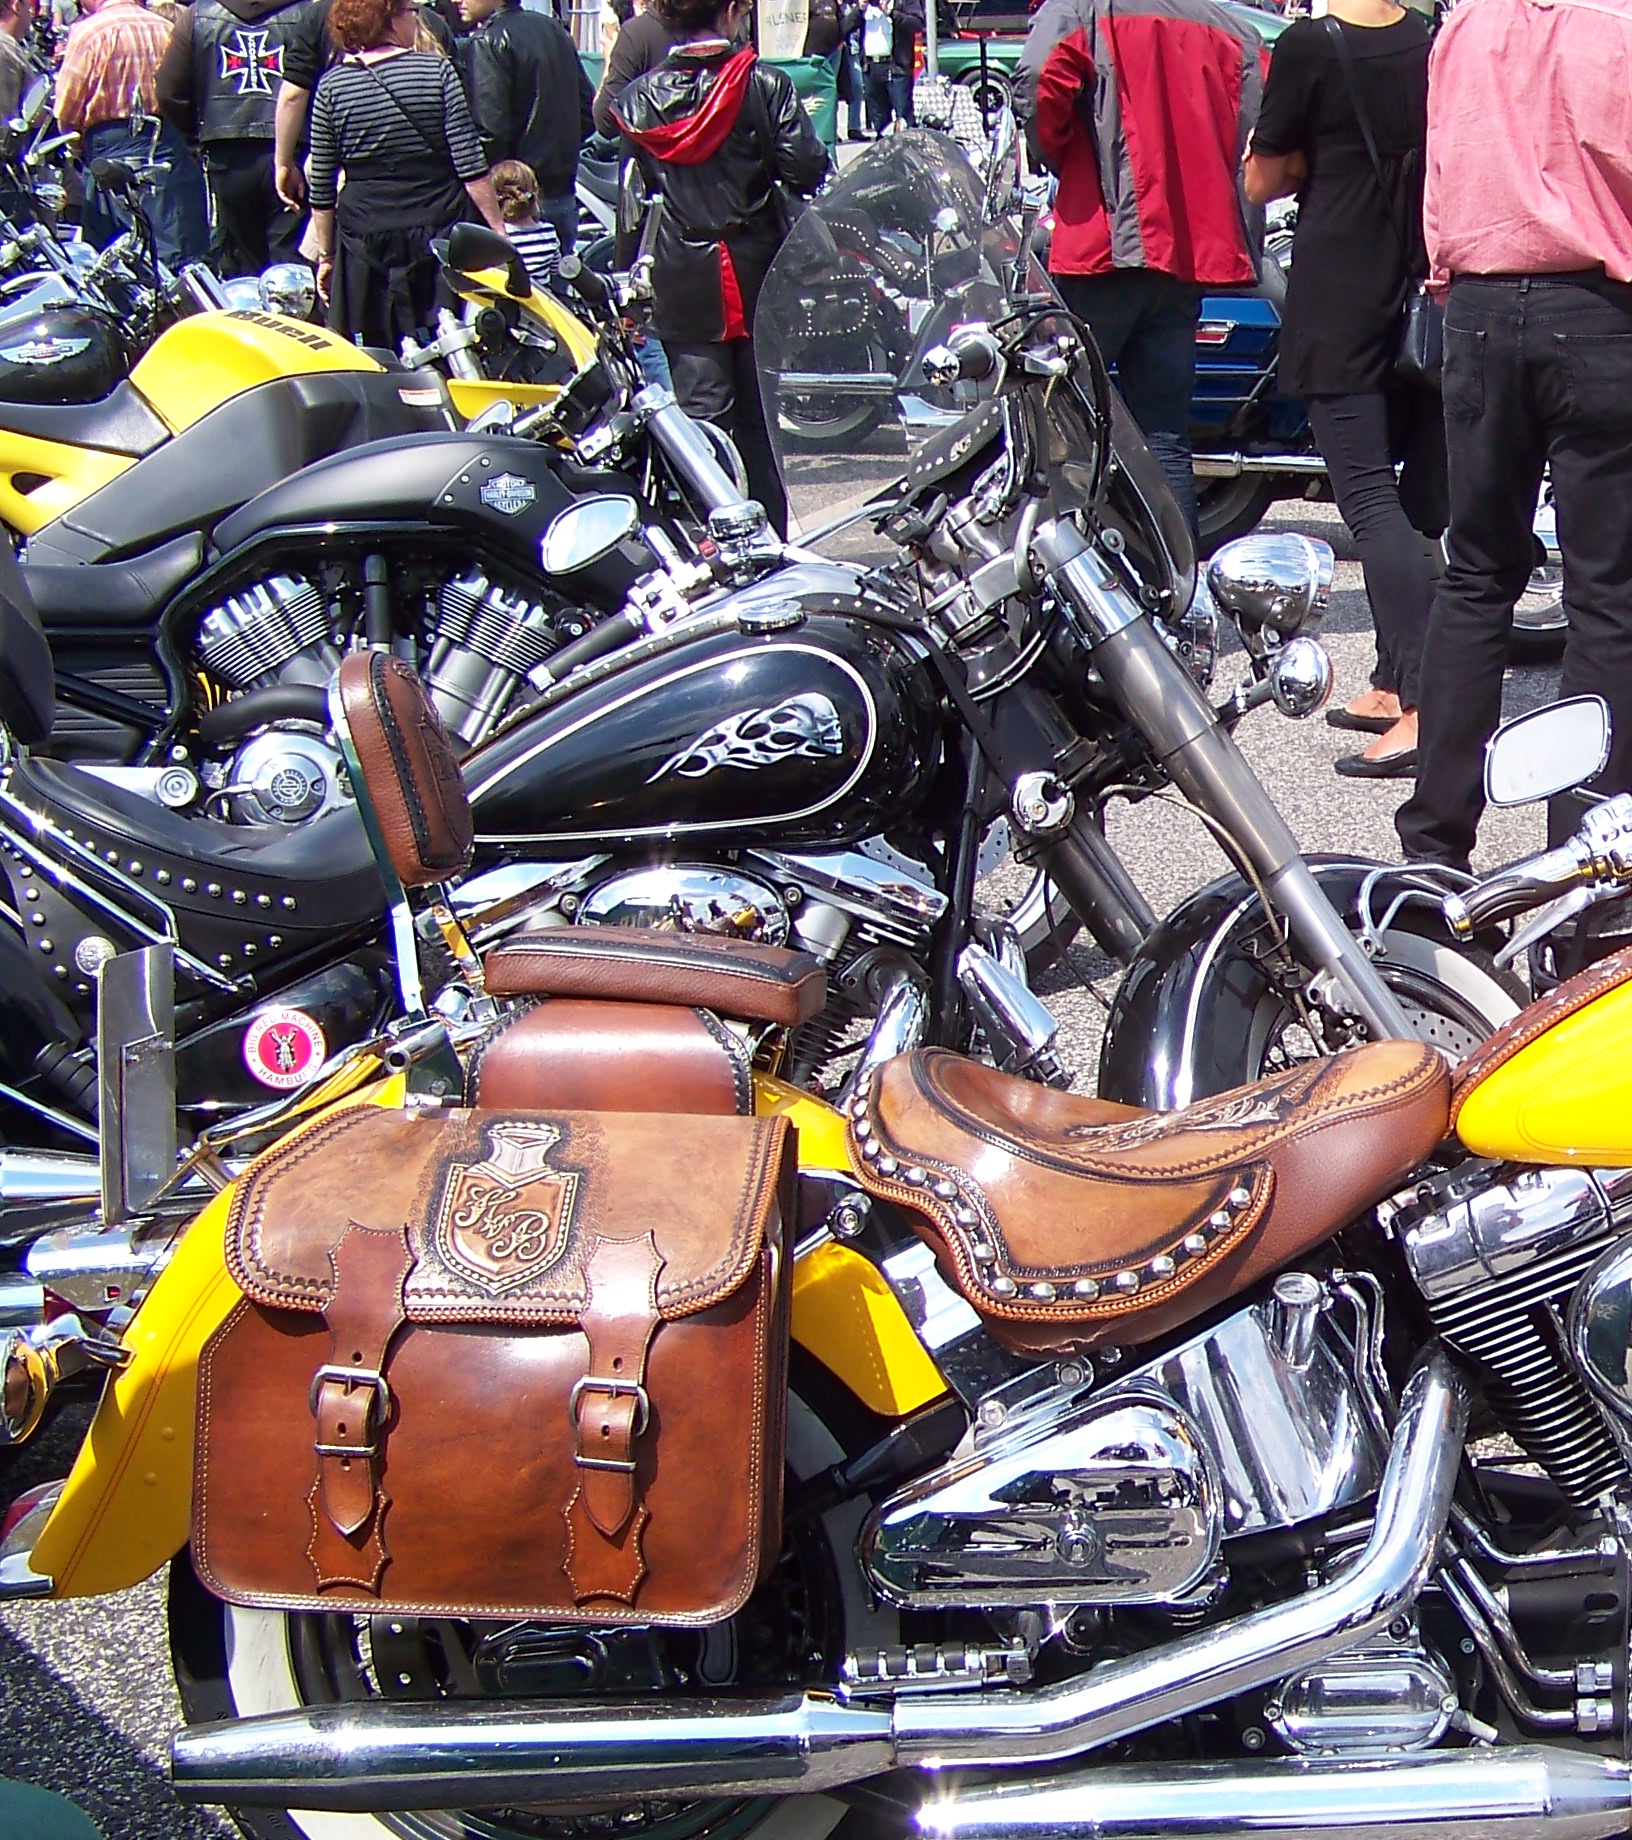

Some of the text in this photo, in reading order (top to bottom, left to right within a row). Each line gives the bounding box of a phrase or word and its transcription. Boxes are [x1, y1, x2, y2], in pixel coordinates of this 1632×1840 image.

[223, 310, 333, 350] Buell
[248, 1035, 258, 1053] BIG
[281, 1012, 323, 1047] MACHINE
